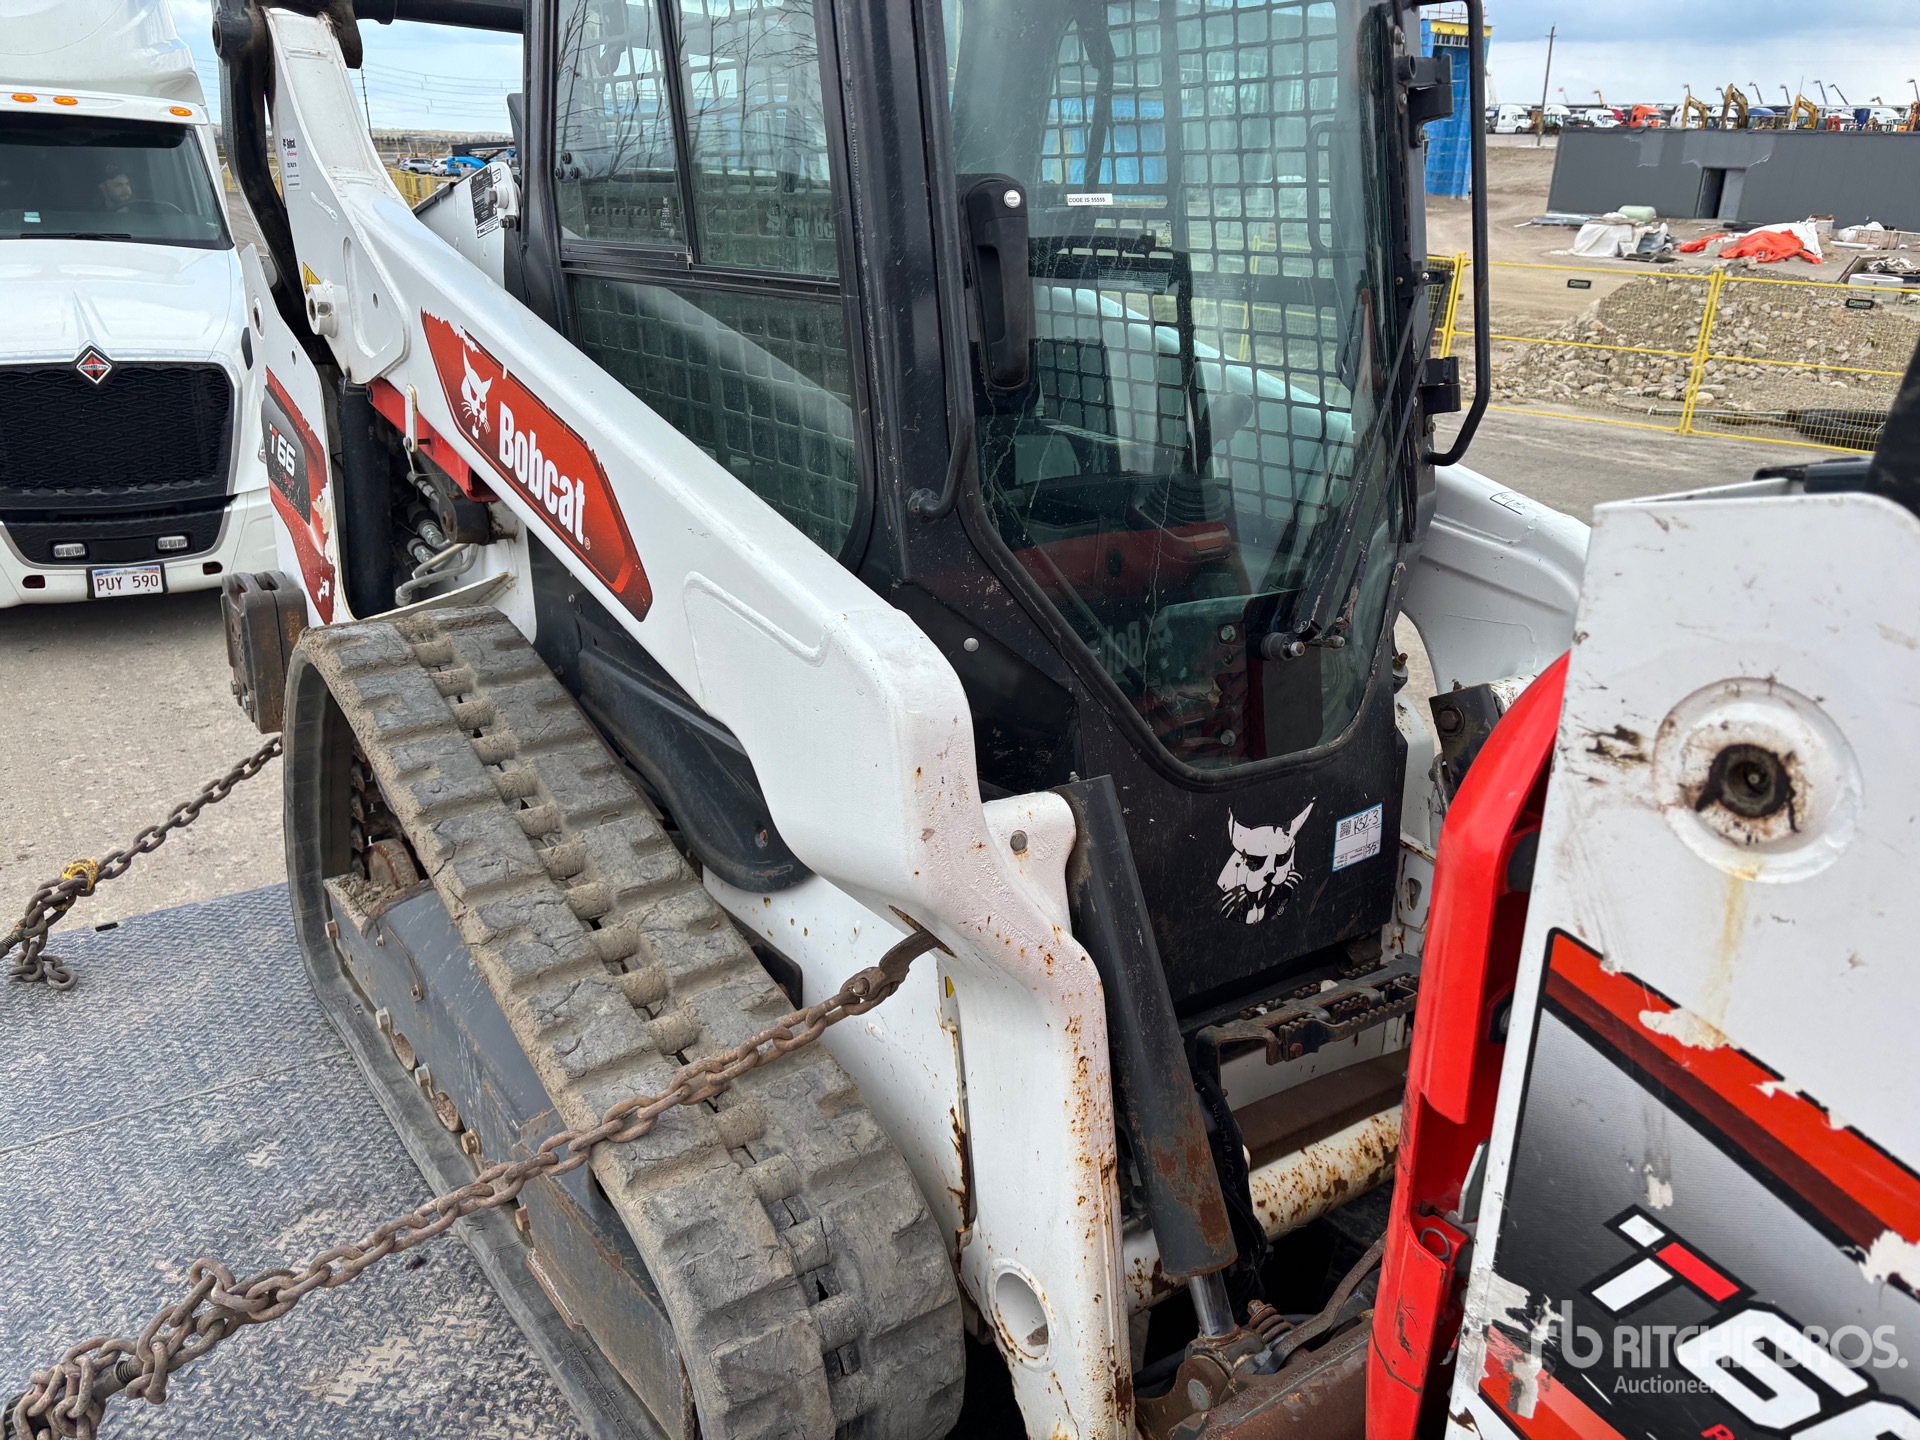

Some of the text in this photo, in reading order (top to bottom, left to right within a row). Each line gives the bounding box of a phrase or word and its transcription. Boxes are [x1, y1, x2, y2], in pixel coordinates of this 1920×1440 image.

[269, 422, 297, 478] T66
[499, 400, 586, 546] Bobcat
[96, 574, 159, 592] PUY 590
